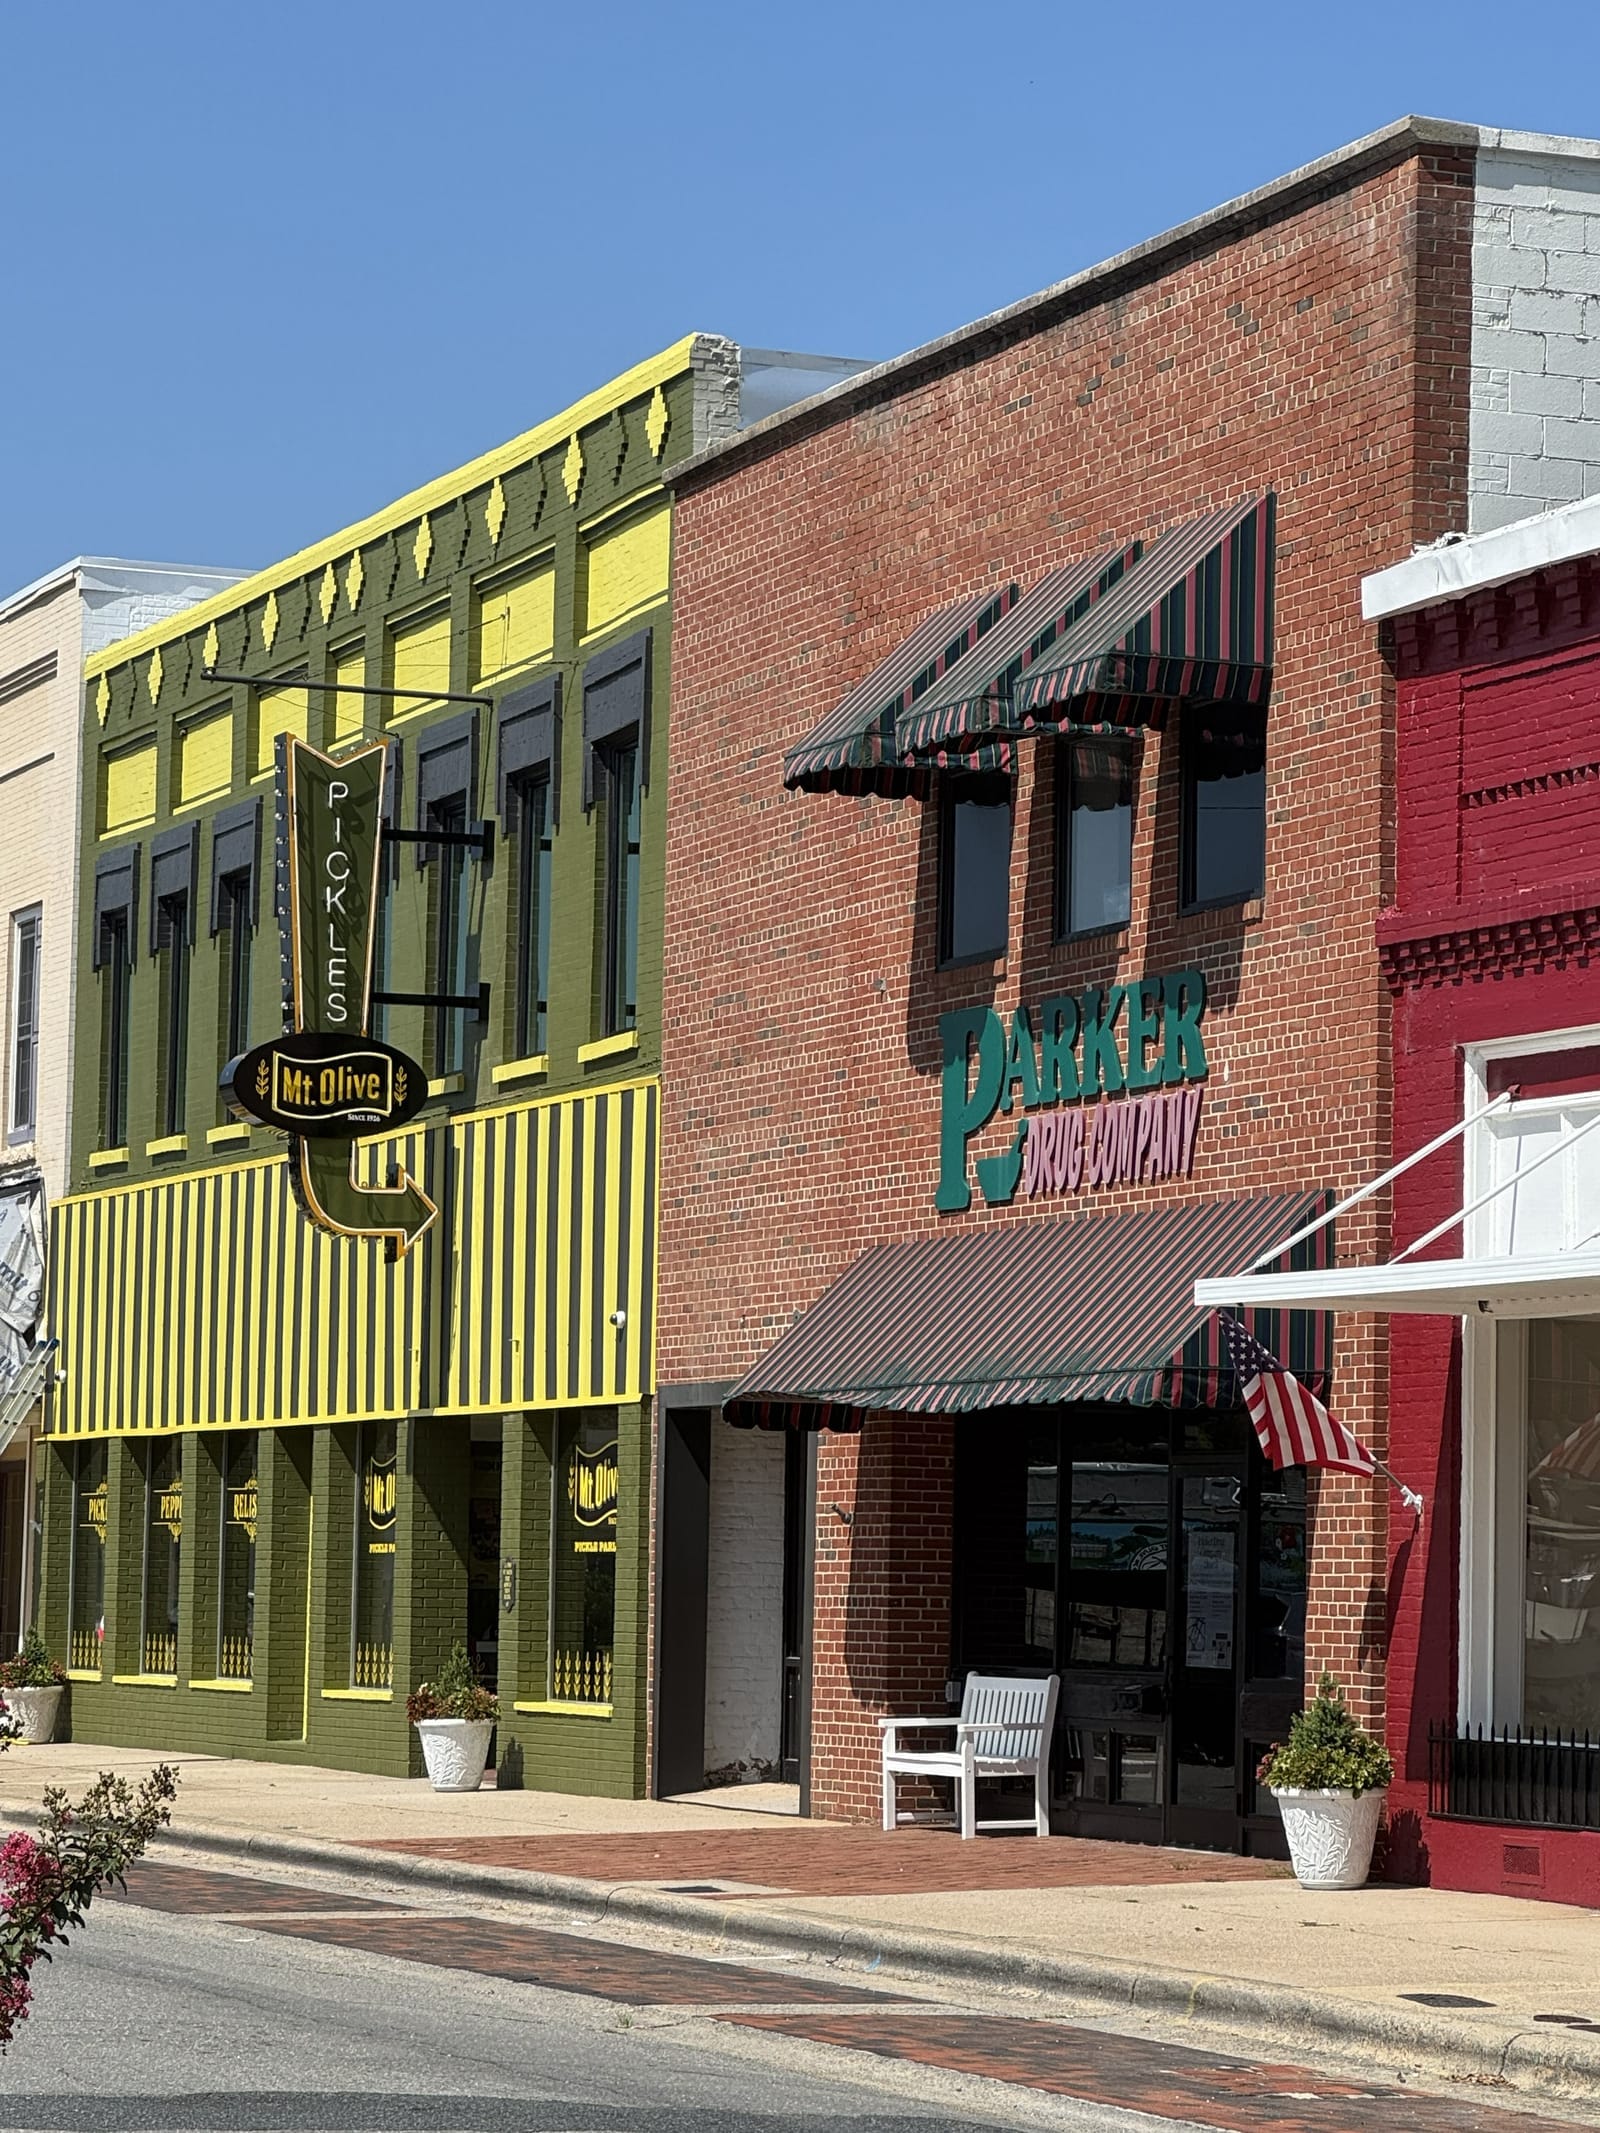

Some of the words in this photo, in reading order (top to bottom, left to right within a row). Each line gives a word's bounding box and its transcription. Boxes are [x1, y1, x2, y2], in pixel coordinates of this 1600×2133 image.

[325, 781, 350, 1023] PICKLES
[283, 1065, 316, 1106] Mt.
[320, 1066, 380, 1105] Olive
[934, 969, 1209, 1212] PARKER
[1024, 1108, 1085, 1197] DRUG
[1088, 1083, 1204, 1187] COMPANY
[595, 1457, 619, 1509] Oliv
